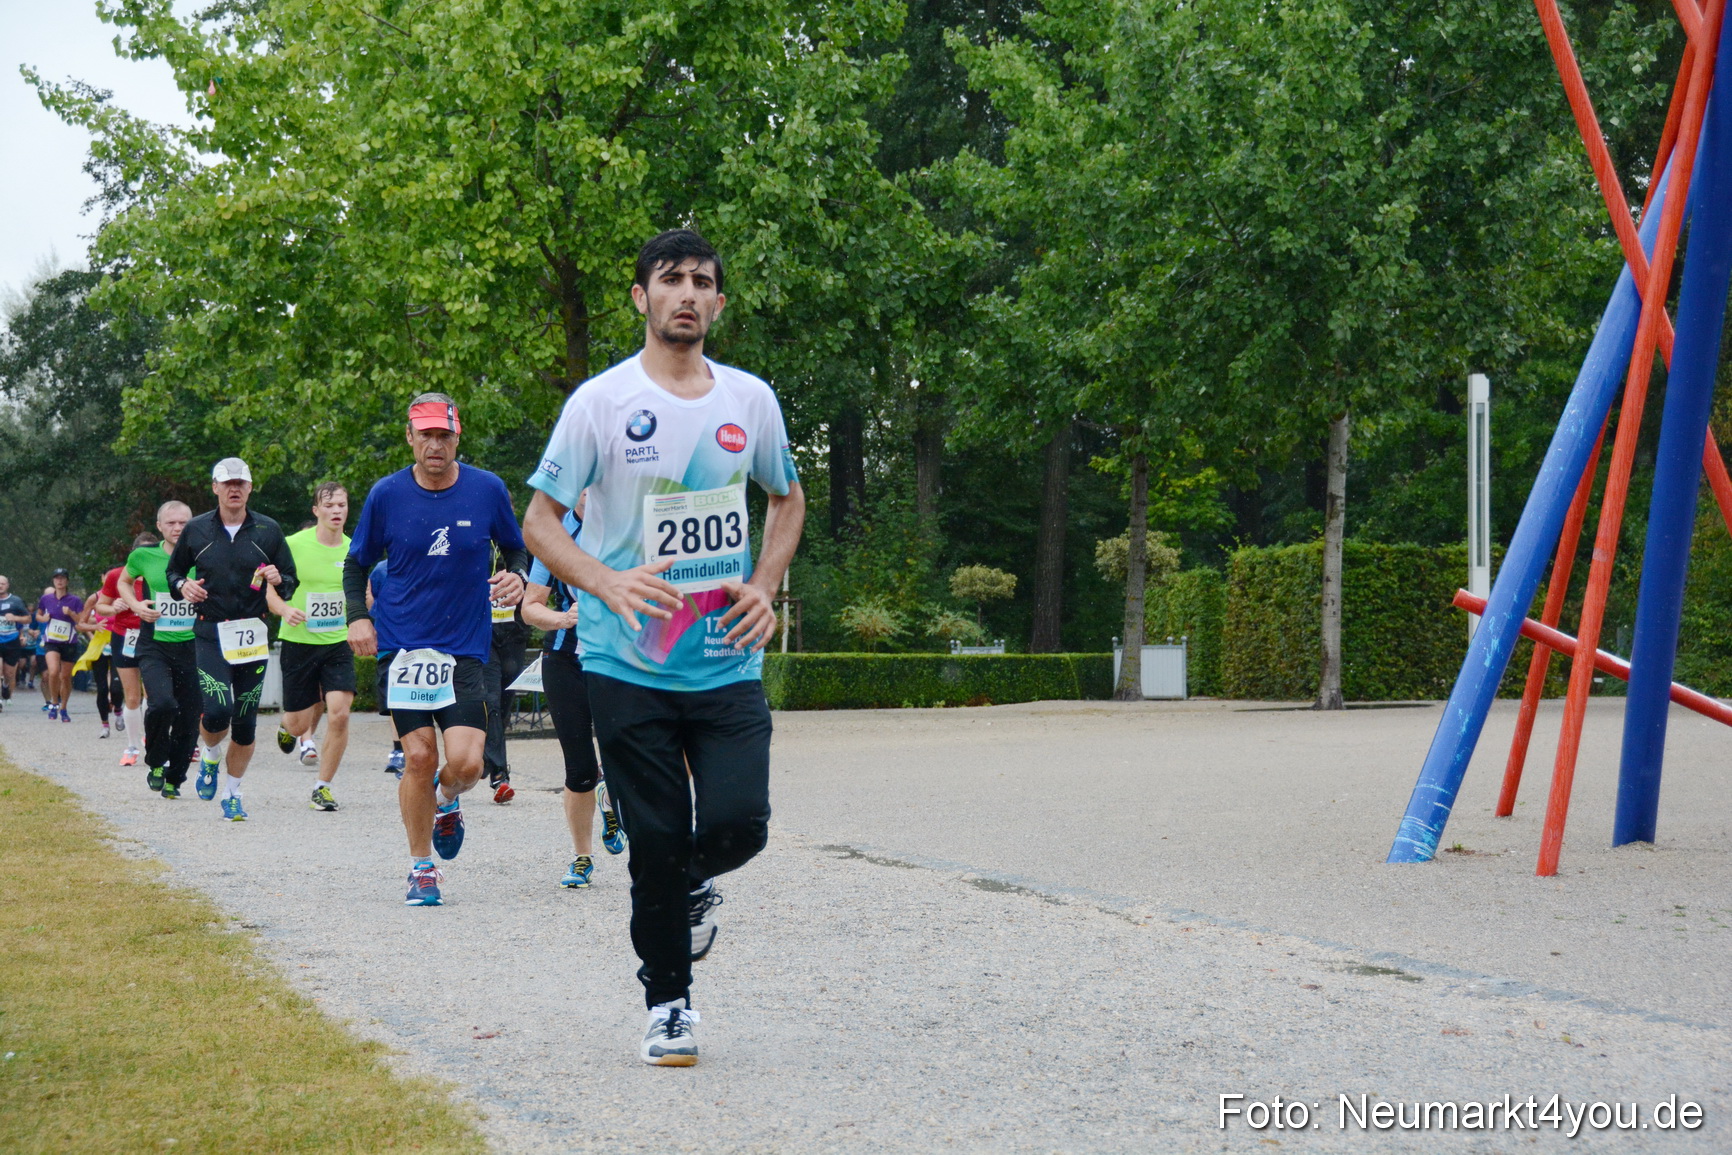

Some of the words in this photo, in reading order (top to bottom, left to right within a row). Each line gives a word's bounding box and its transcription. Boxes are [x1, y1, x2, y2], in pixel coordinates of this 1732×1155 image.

[625, 446, 659, 457] PARTL
[626, 455, 660, 464] Neumarkt
[694, 489, 737, 507] BOCK
[657, 511, 742, 556] 2803
[662, 558, 740, 581] Hamidullah
[160, 602, 196, 617] 2056
[311, 600, 343, 617] 2353
[54, 625, 68, 634] 167
[705, 616, 728, 633] 17.
[235, 629, 255, 646] 73
[703, 648, 745, 657] Stadtlauf
[410, 690, 438, 701] Dieter
